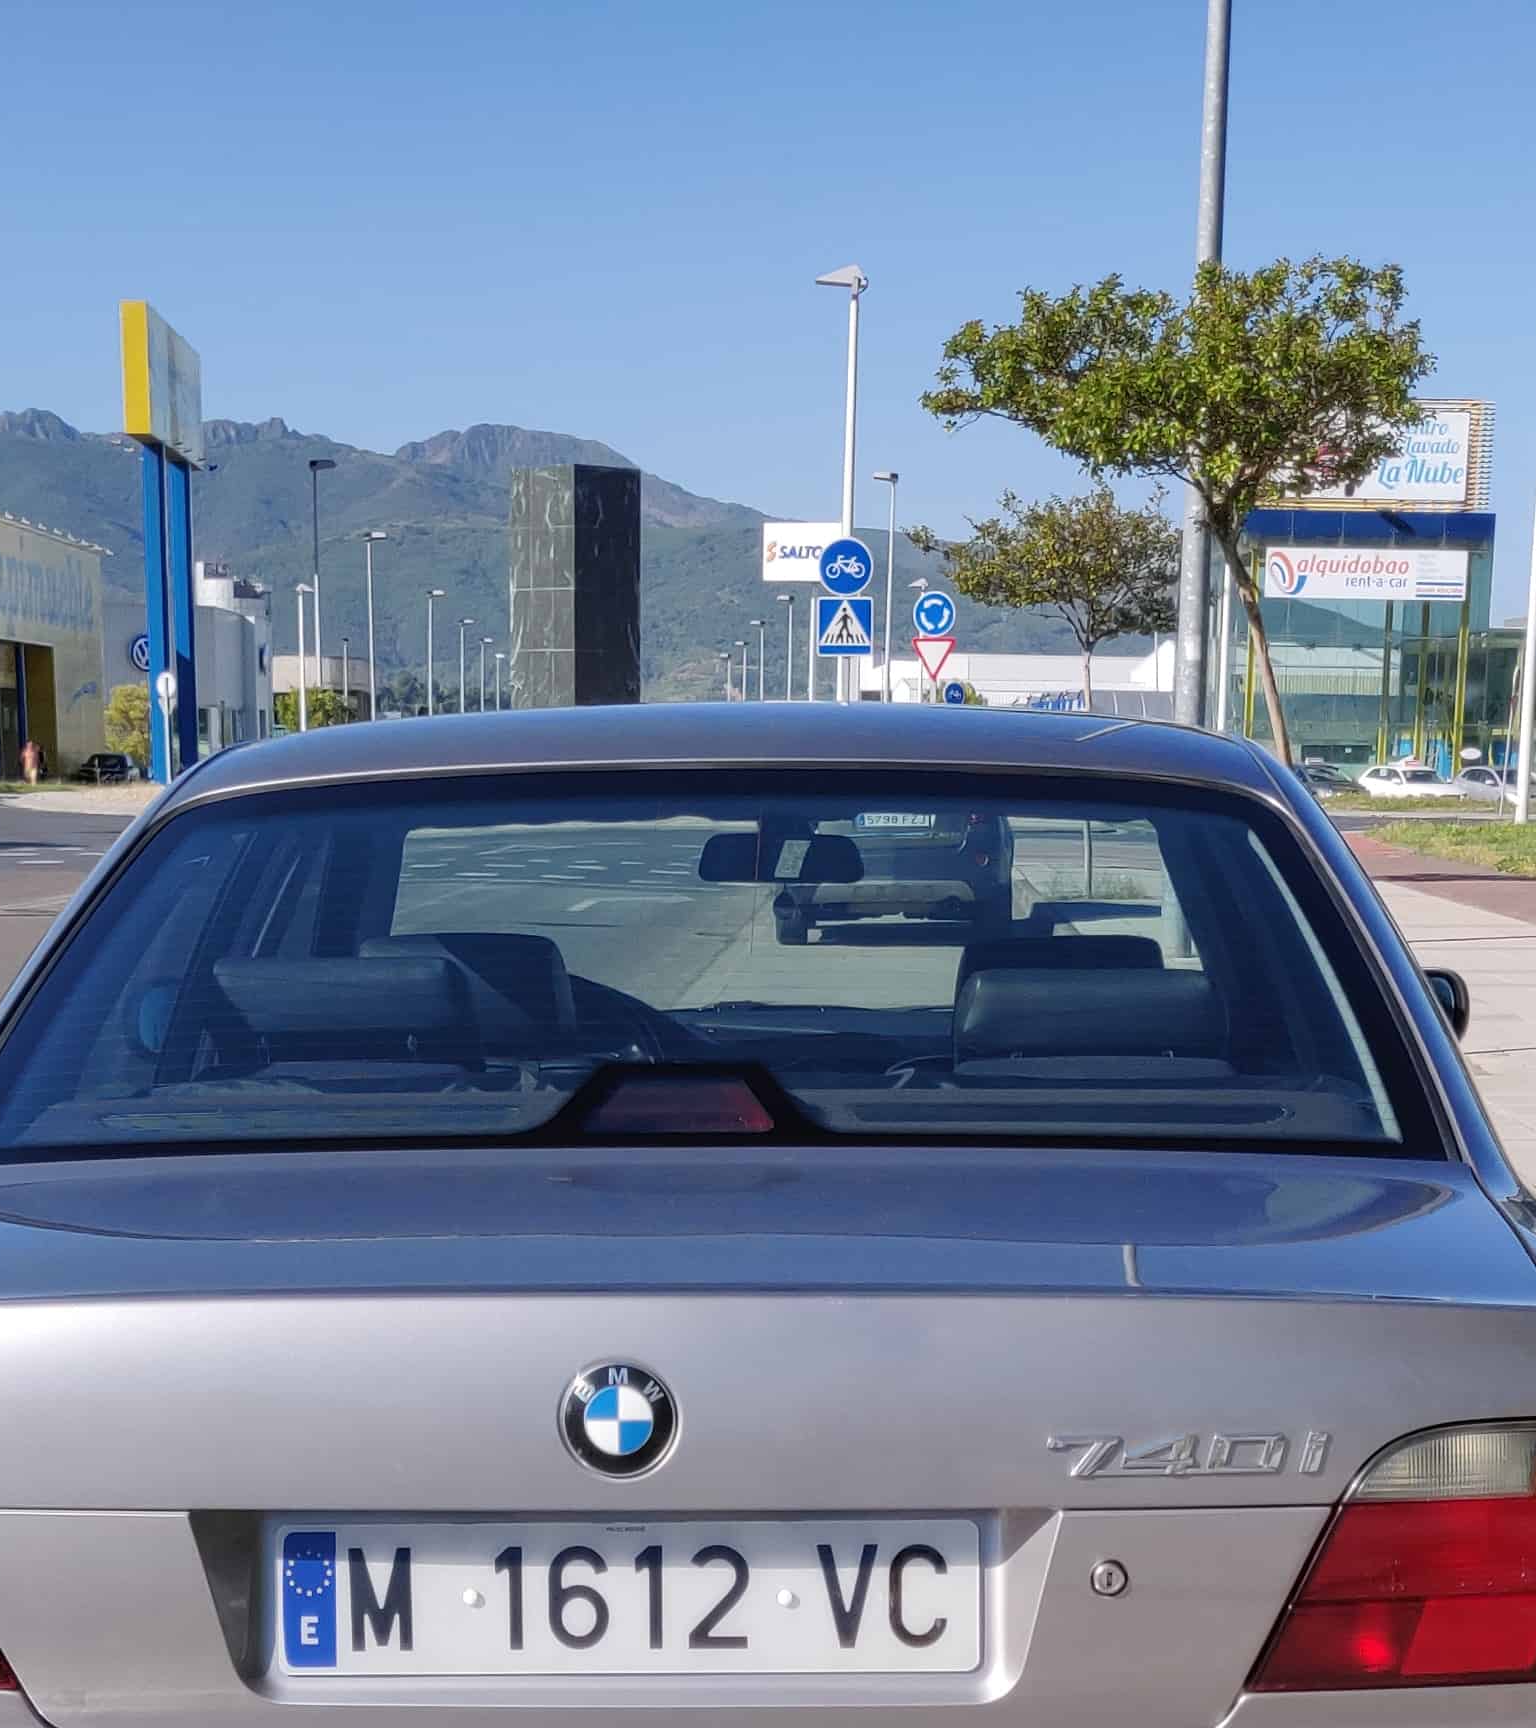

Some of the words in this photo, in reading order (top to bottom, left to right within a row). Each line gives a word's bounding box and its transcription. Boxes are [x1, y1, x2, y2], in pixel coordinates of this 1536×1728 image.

[1376, 457, 1401, 490] La
[1404, 458, 1465, 485] Nube
[1296, 553, 1409, 577] alquidobao
[1344, 575, 1408, 589] rent-a-car
[574, 1367, 665, 1403] BMW
[1046, 1431, 1333, 1478] 740i
[348, 1547, 413, 1652] M
[494, 1544, 750, 1650] 1612
[815, 1543, 949, 1649] VC
[300, 1615, 320, 1645] E
